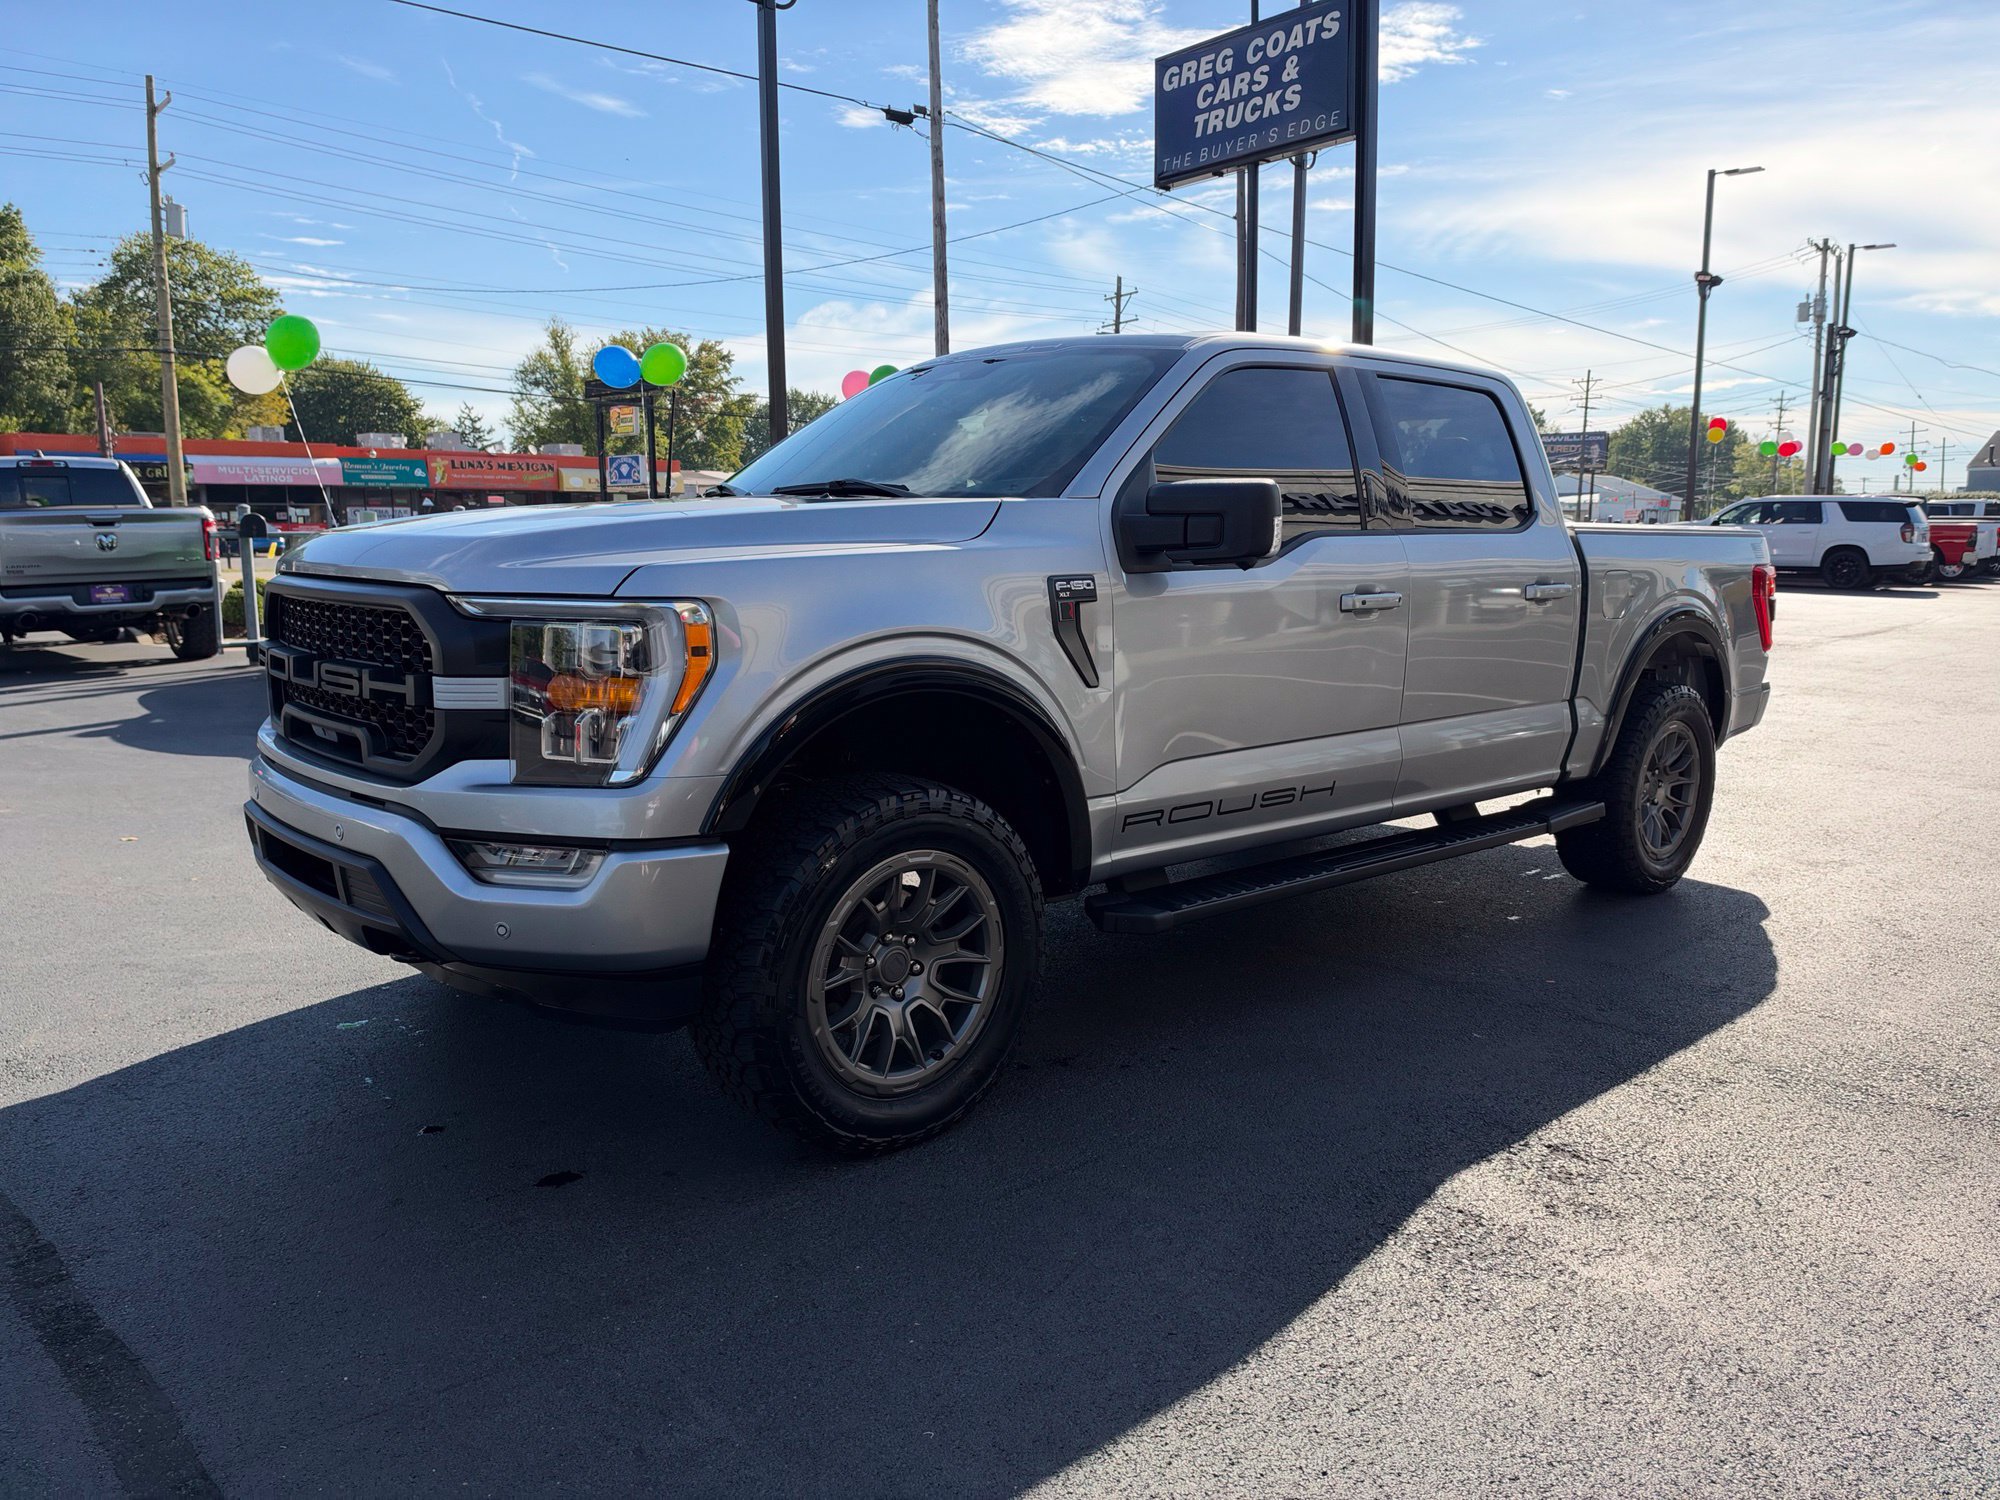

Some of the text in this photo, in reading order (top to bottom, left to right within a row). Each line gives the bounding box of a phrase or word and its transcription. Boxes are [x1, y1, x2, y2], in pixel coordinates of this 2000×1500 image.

[1162, 10, 1341, 92] GREG COATS
[1196, 55, 1300, 109] CARS &
[1193, 84, 1302, 138] TRUCKS
[1162, 110, 1341, 173] THE BUYER'S EDGE
[244, 474, 294, 483] LATINOS
[450, 459, 555, 473] LUNA'S MEXICAN
[1055, 580, 1095, 591] F-150
[1120, 780, 1337, 833] ROUSH
